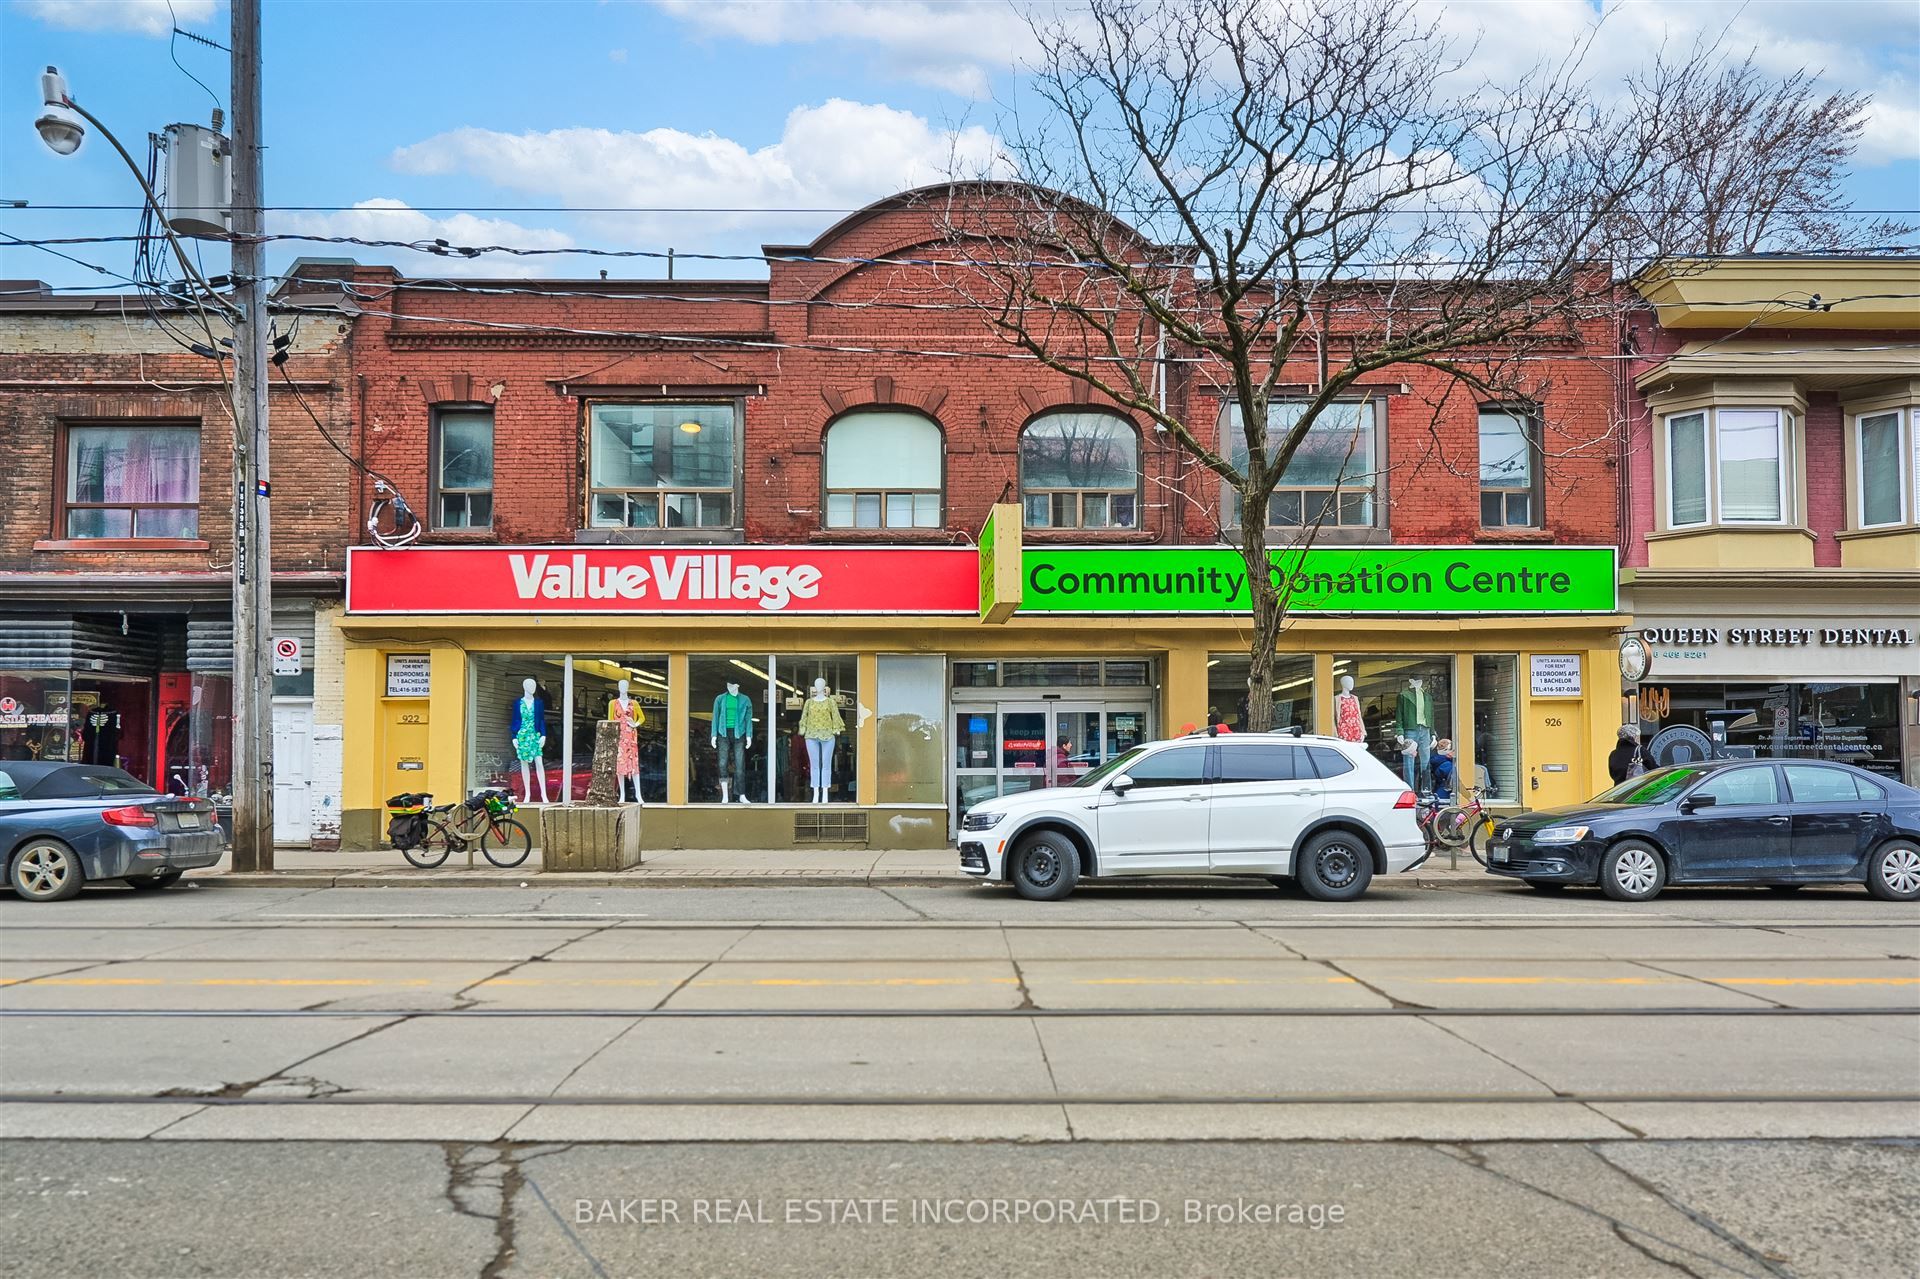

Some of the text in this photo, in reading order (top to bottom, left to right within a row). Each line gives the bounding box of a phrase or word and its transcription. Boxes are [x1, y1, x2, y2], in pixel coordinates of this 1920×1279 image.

[508, 554, 823, 610] Value Village
[1030, 562, 1571, 602] Community Donation Centre
[1643, 628, 1915, 645] QUEEN STREET DENTAL
[0, 714, 26, 723] ASTLE
[1545, 718, 1562, 726] 926
[1755, 743, 1883, 751] ww.queenstreetdentalcentre.ca
